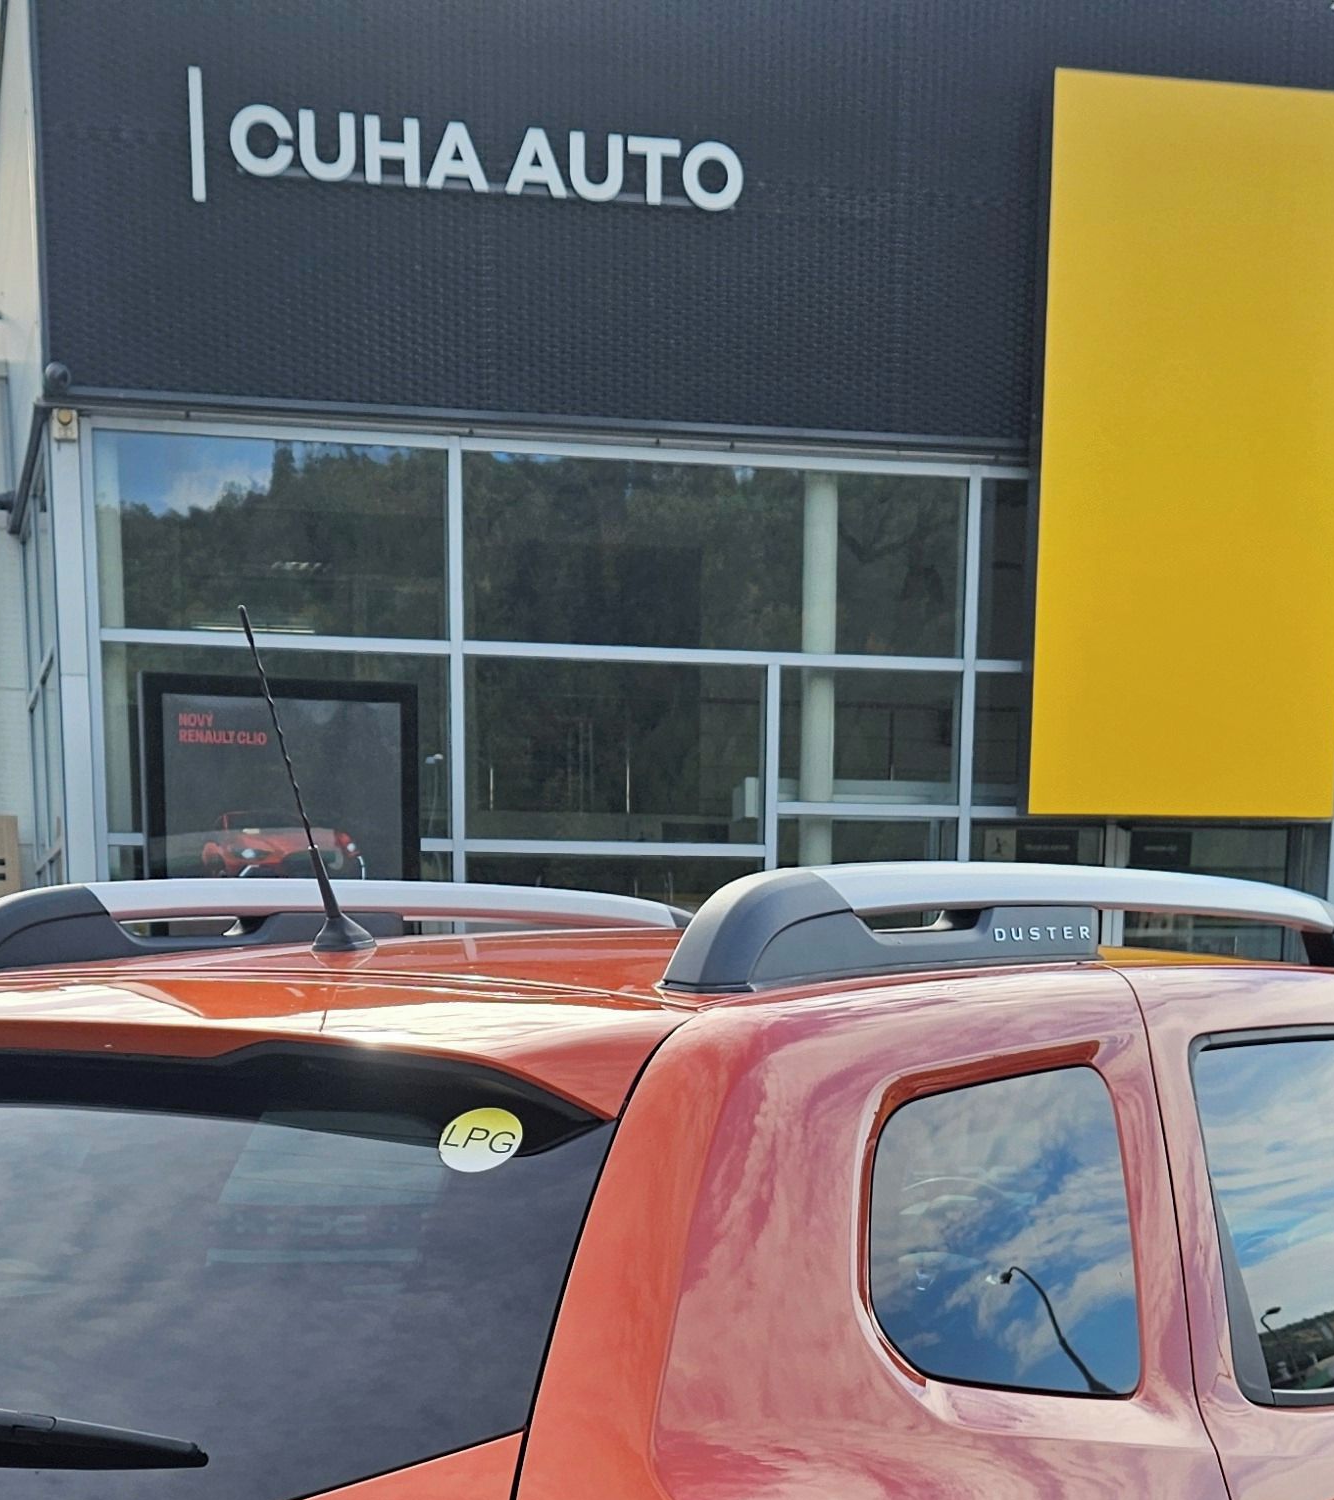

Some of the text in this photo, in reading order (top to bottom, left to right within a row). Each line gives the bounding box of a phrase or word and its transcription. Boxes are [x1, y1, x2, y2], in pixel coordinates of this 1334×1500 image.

[229, 103, 744, 211] CUHA AUTO
[178, 729, 267, 745] RENAULT CLIO
[994, 925, 1091, 942] DUSTER
[442, 1124, 516, 1154] LPG
